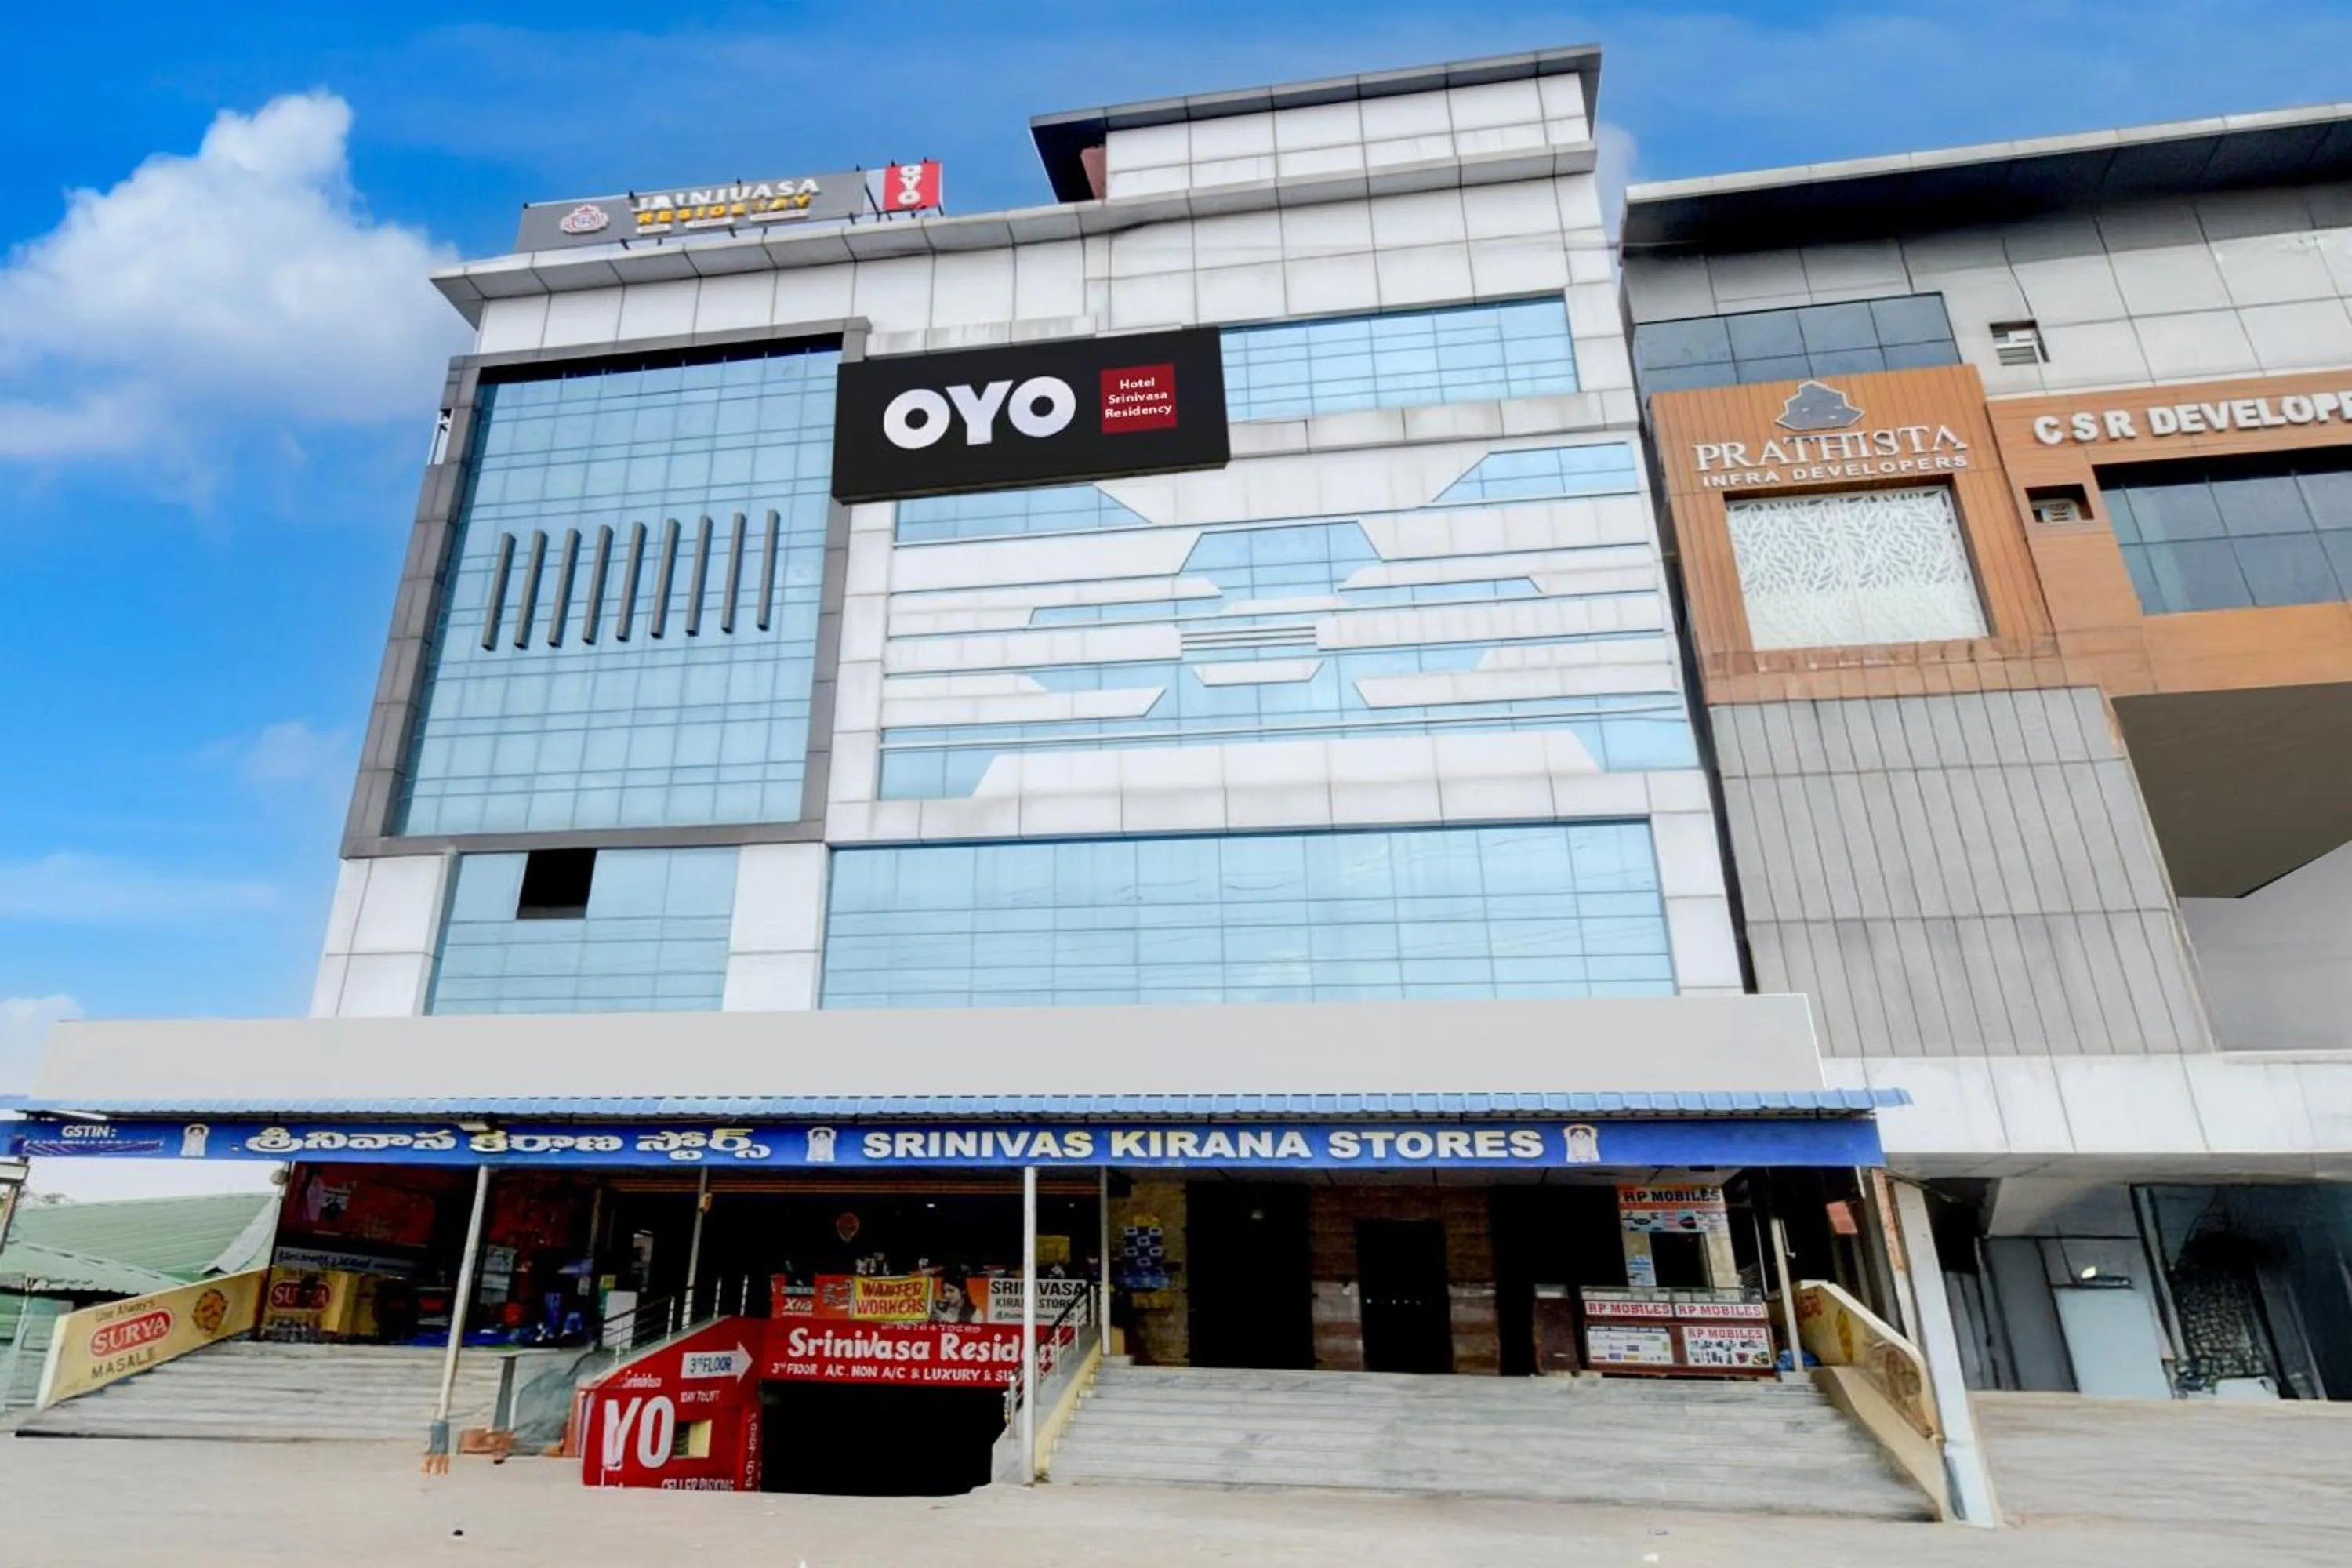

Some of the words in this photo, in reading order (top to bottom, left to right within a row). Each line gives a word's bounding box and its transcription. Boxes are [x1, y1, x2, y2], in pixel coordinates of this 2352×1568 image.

[1120, 377, 1155, 390] Hotel
[1108, 392, 1168, 405] Srinivasa
[884, 376, 1076, 449] OYO
[1105, 405, 1172, 418] Residency
[1692, 425, 1969, 470] PRATHISTA
[1703, 471, 1780, 488] INFRA
[1793, 455, 1968, 481] DEVELOPERS
[863, 1131, 1093, 1159] SRINIVAS
[1111, 1131, 1312, 1158] KIRANA
[1328, 1131, 1544, 1158] STORES
[991, 1280, 1086, 1296] SRIVASA
[274, 1287, 328, 1306] SUA
[995, 1298, 1029, 1308] KIRA
[1038, 1298, 1077, 1308] STOR
[855, 1298, 925, 1315] WORKERS
[1610, 1305, 1670, 1316] MOBILES
[1700, 1305, 1761, 1316] MOBILES
[92, 1316, 169, 1354] SURYA
[1708, 1330, 1763, 1339] MOBILES
[787, 1327, 931, 1360] Srinivasa
[851, 1365, 878, 1377] NON
[882, 1367, 906, 1379] A/C
[924, 1369, 981, 1381] LUXURY
